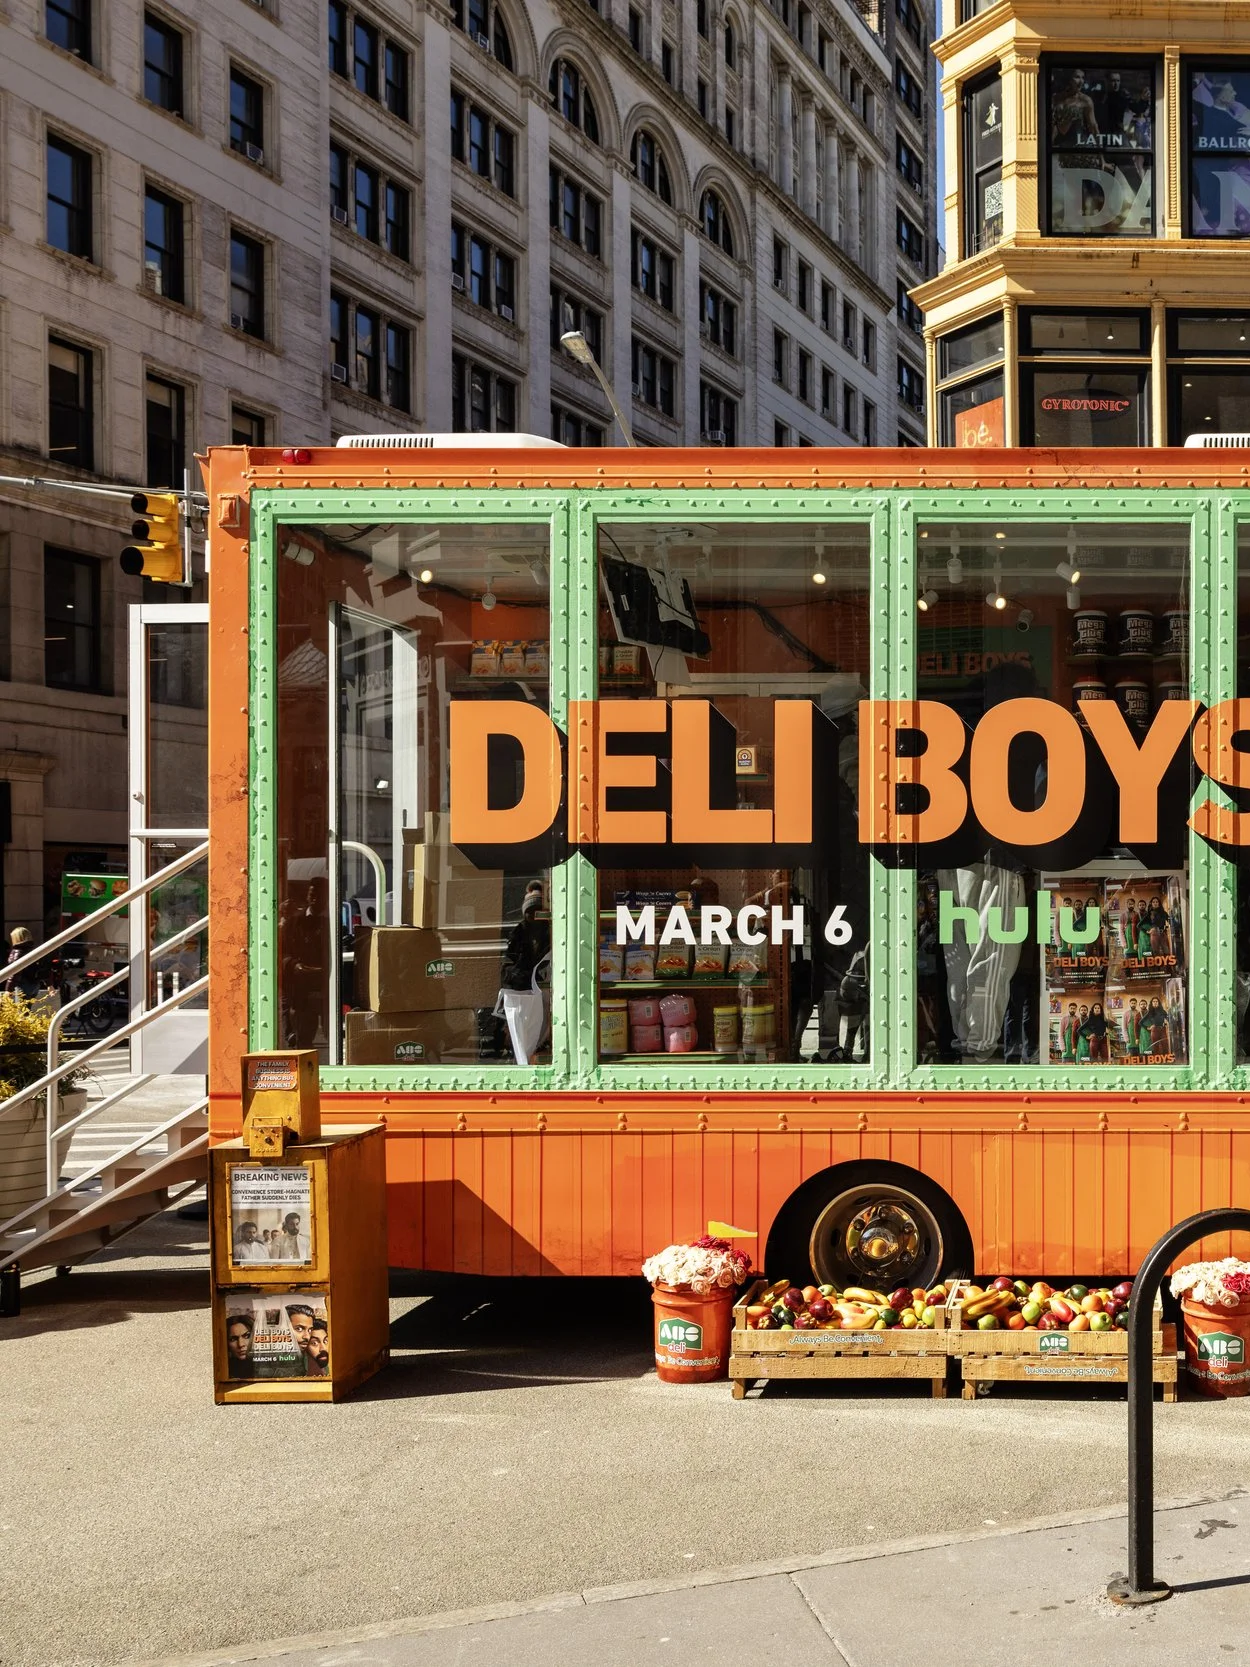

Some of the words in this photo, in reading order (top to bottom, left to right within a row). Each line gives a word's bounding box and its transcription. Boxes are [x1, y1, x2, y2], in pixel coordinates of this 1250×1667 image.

[1076, 133, 1123, 146] LATIN
[917, 652, 958, 674] ELI
[449, 699, 822, 852] DELI
[939, 890, 1100, 944] hulu
[616, 905, 804, 946] MARCH
[824, 905, 853, 946] 6
[428, 963, 453, 972] ABC
[1054, 957, 1078, 967] DELI
[1080, 957, 1108, 967] BOYS
[1121, 958, 1145, 968] DELI
[1147, 955, 1177, 967] BOYS
[397, 1045, 423, 1054] ABC
[234, 1173, 279, 1182] BREAKING
[281, 1173, 308, 1181] NEWS
[661, 1323, 699, 1341] ABC
[254, 1335, 271, 1343] DELI
[790, 1334, 821, 1345] Always
[823, 1334, 834, 1343] Be
[835, 1334, 884, 1344] Convenient
[1041, 1337, 1068, 1347] ABC
[668, 1341, 686, 1353] deli
[1199, 1338, 1241, 1355] ABC
[1208, 1355, 1229, 1368] deli
[1024, 1365, 1072, 1377] Convenient
[1073, 1367, 1084, 1376] Be
[1086, 1366, 1118, 1377] Always
